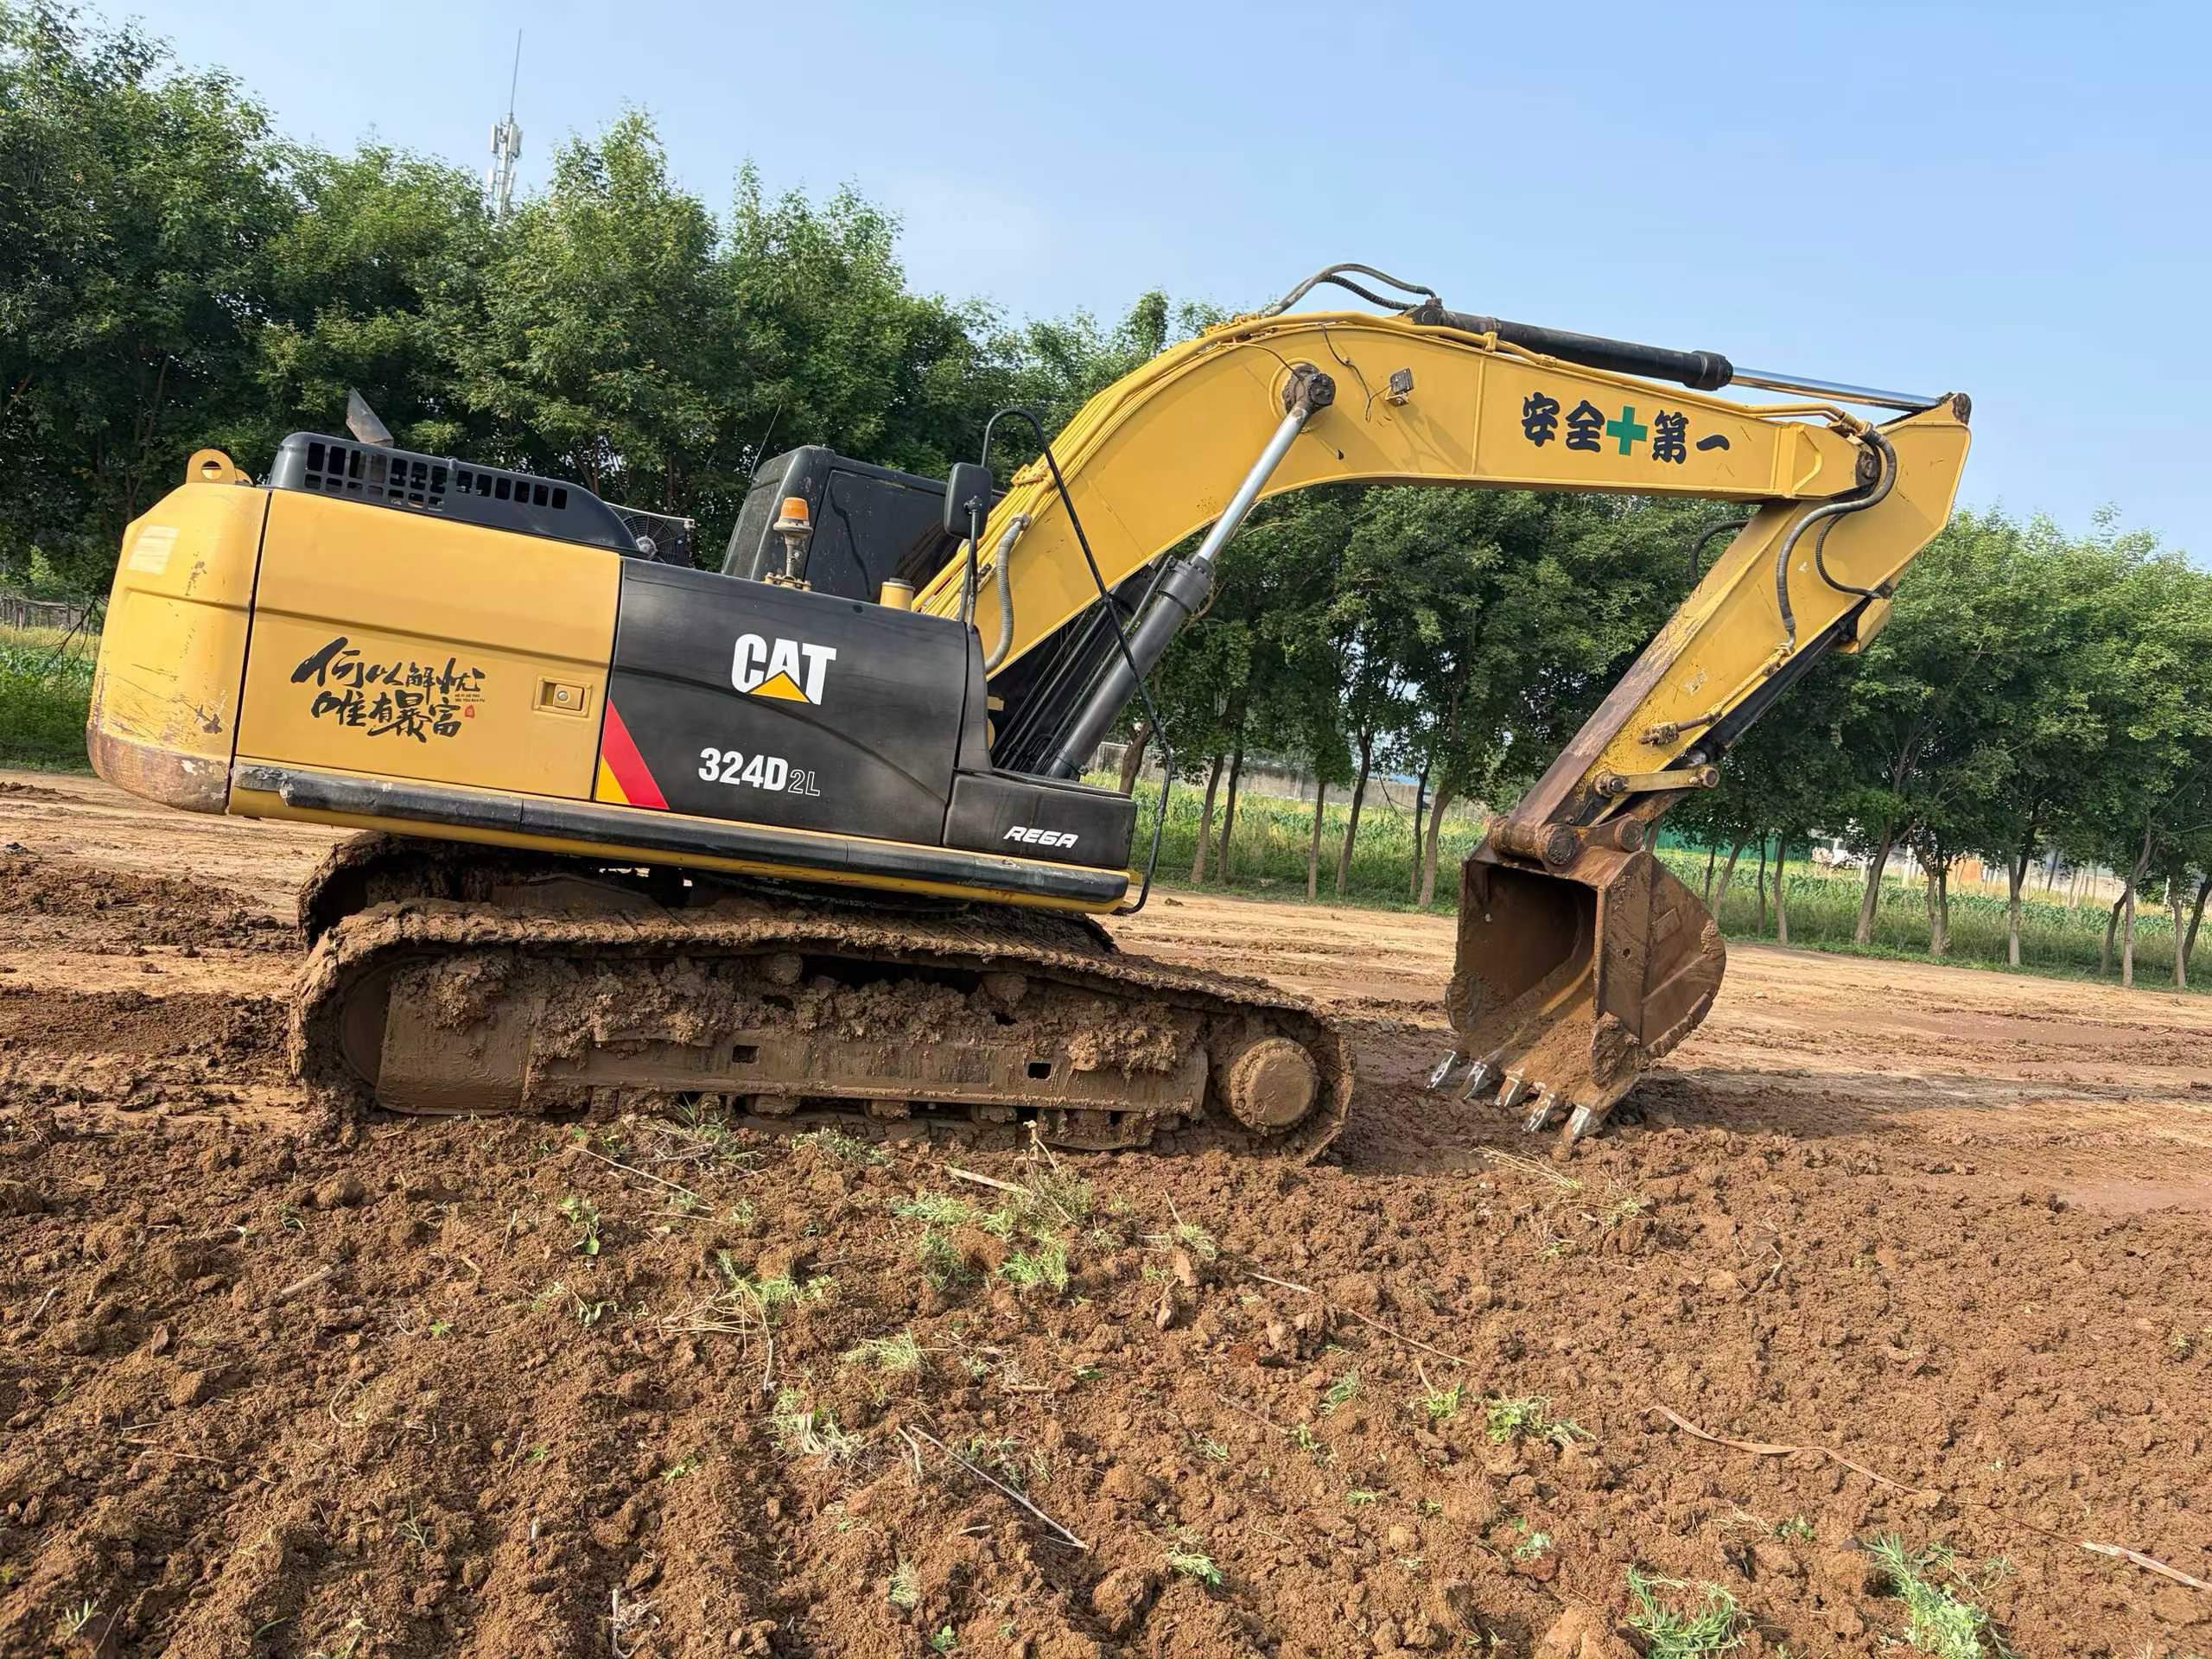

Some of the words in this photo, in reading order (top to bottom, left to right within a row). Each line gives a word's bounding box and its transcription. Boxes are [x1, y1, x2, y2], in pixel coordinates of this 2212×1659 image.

[290, 637, 486, 704] 何以解忧
[732, 633, 837, 705] CAT
[311, 690, 461, 742] 唯有暴富
[1003, 825, 1079, 849] REGA
